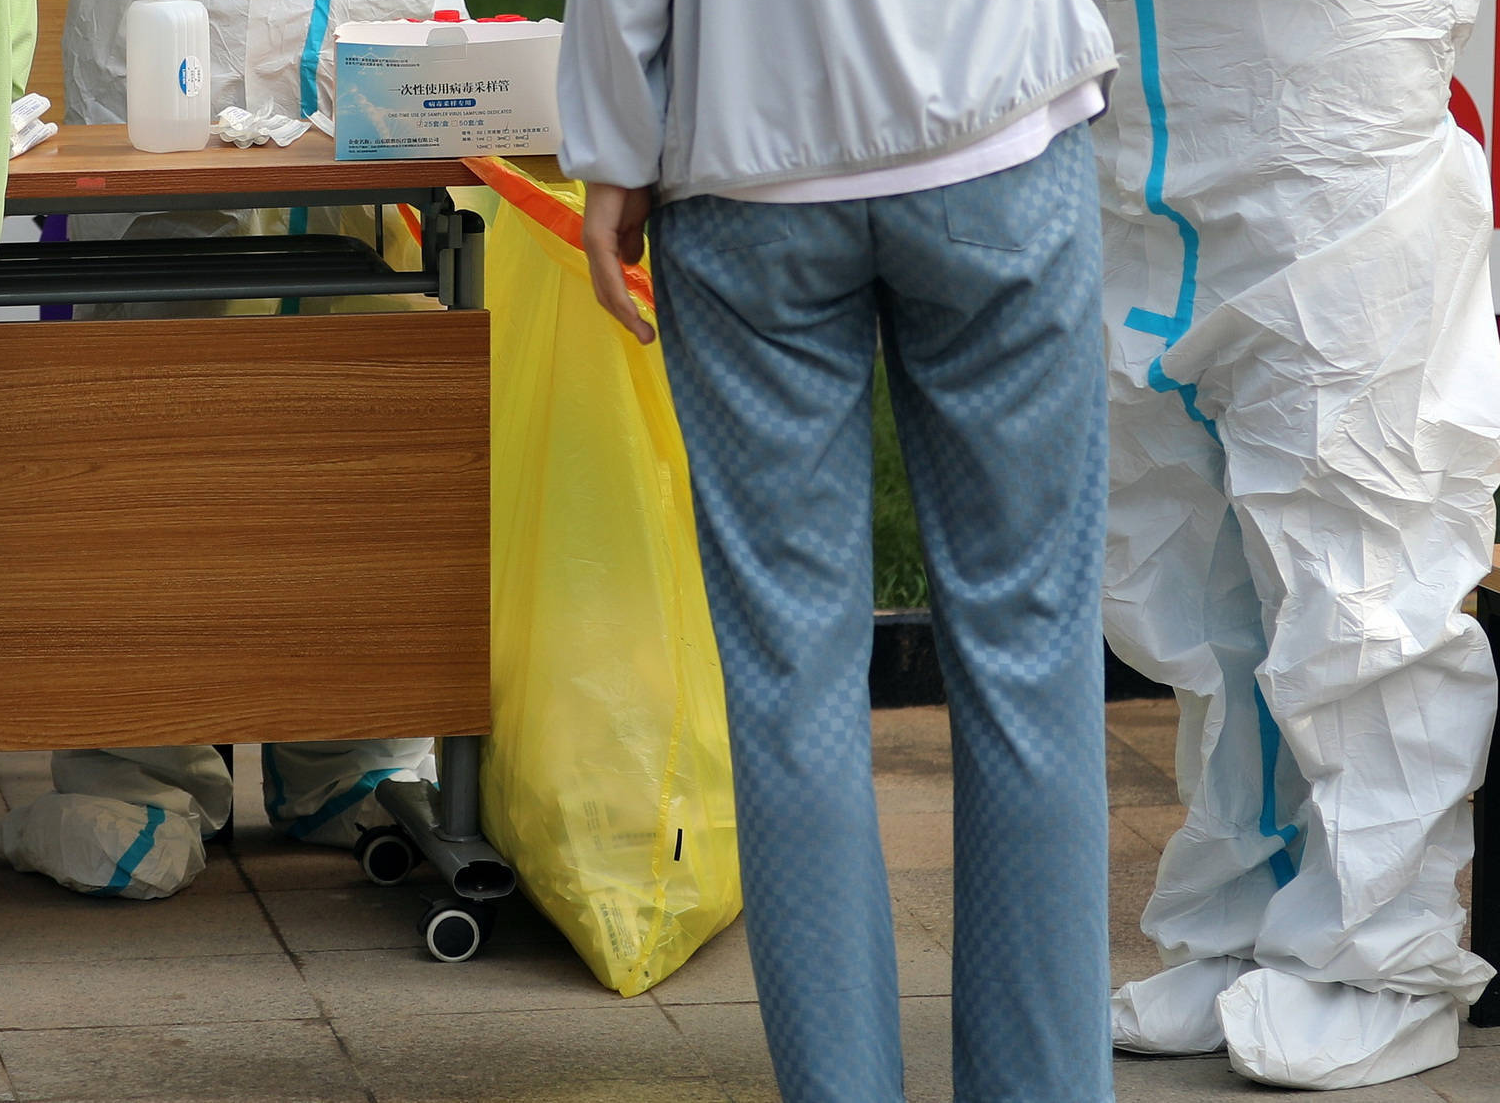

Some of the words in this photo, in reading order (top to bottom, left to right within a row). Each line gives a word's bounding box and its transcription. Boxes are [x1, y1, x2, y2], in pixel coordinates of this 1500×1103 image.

[388, 79, 510, 97] 一次性使用病毒采样管
